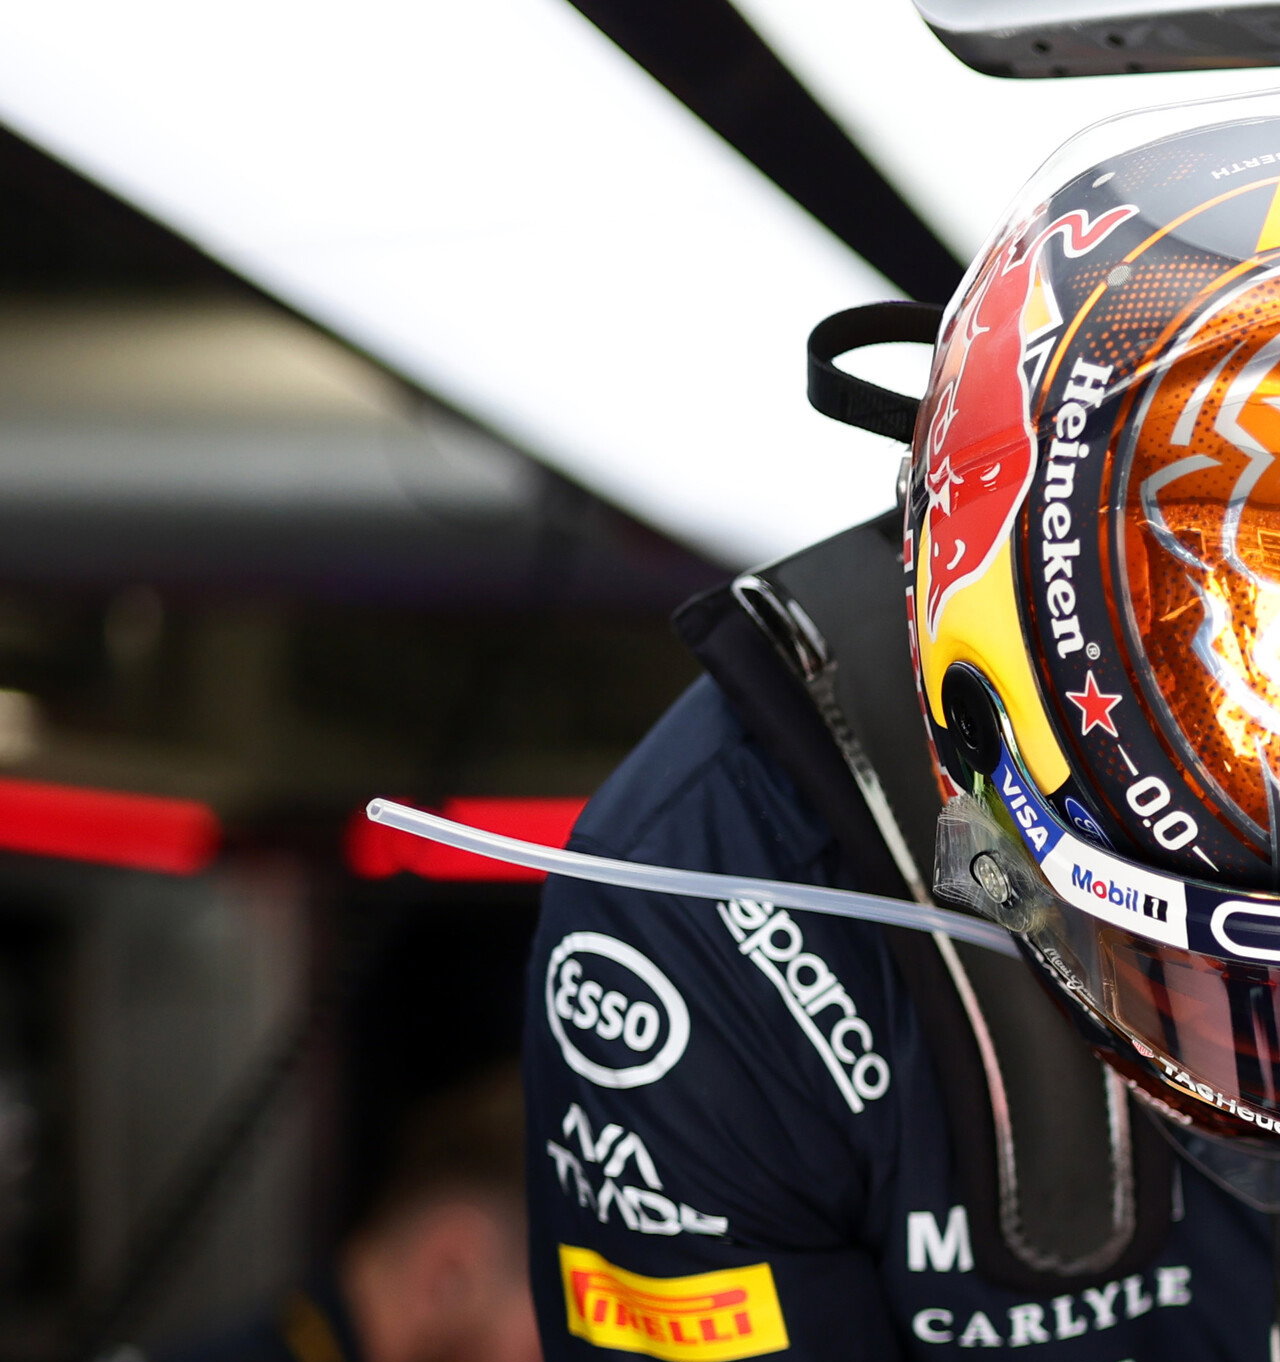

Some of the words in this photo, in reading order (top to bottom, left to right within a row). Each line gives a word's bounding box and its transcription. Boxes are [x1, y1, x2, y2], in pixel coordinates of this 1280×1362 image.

[1042, 357, 1114, 660] Heineken
[1004, 764, 1050, 852] VISA
[1071, 863, 1139, 913] Mobil
[721, 898, 891, 1107] sparco
[911, 1265, 1193, 1348] CARLYLE
